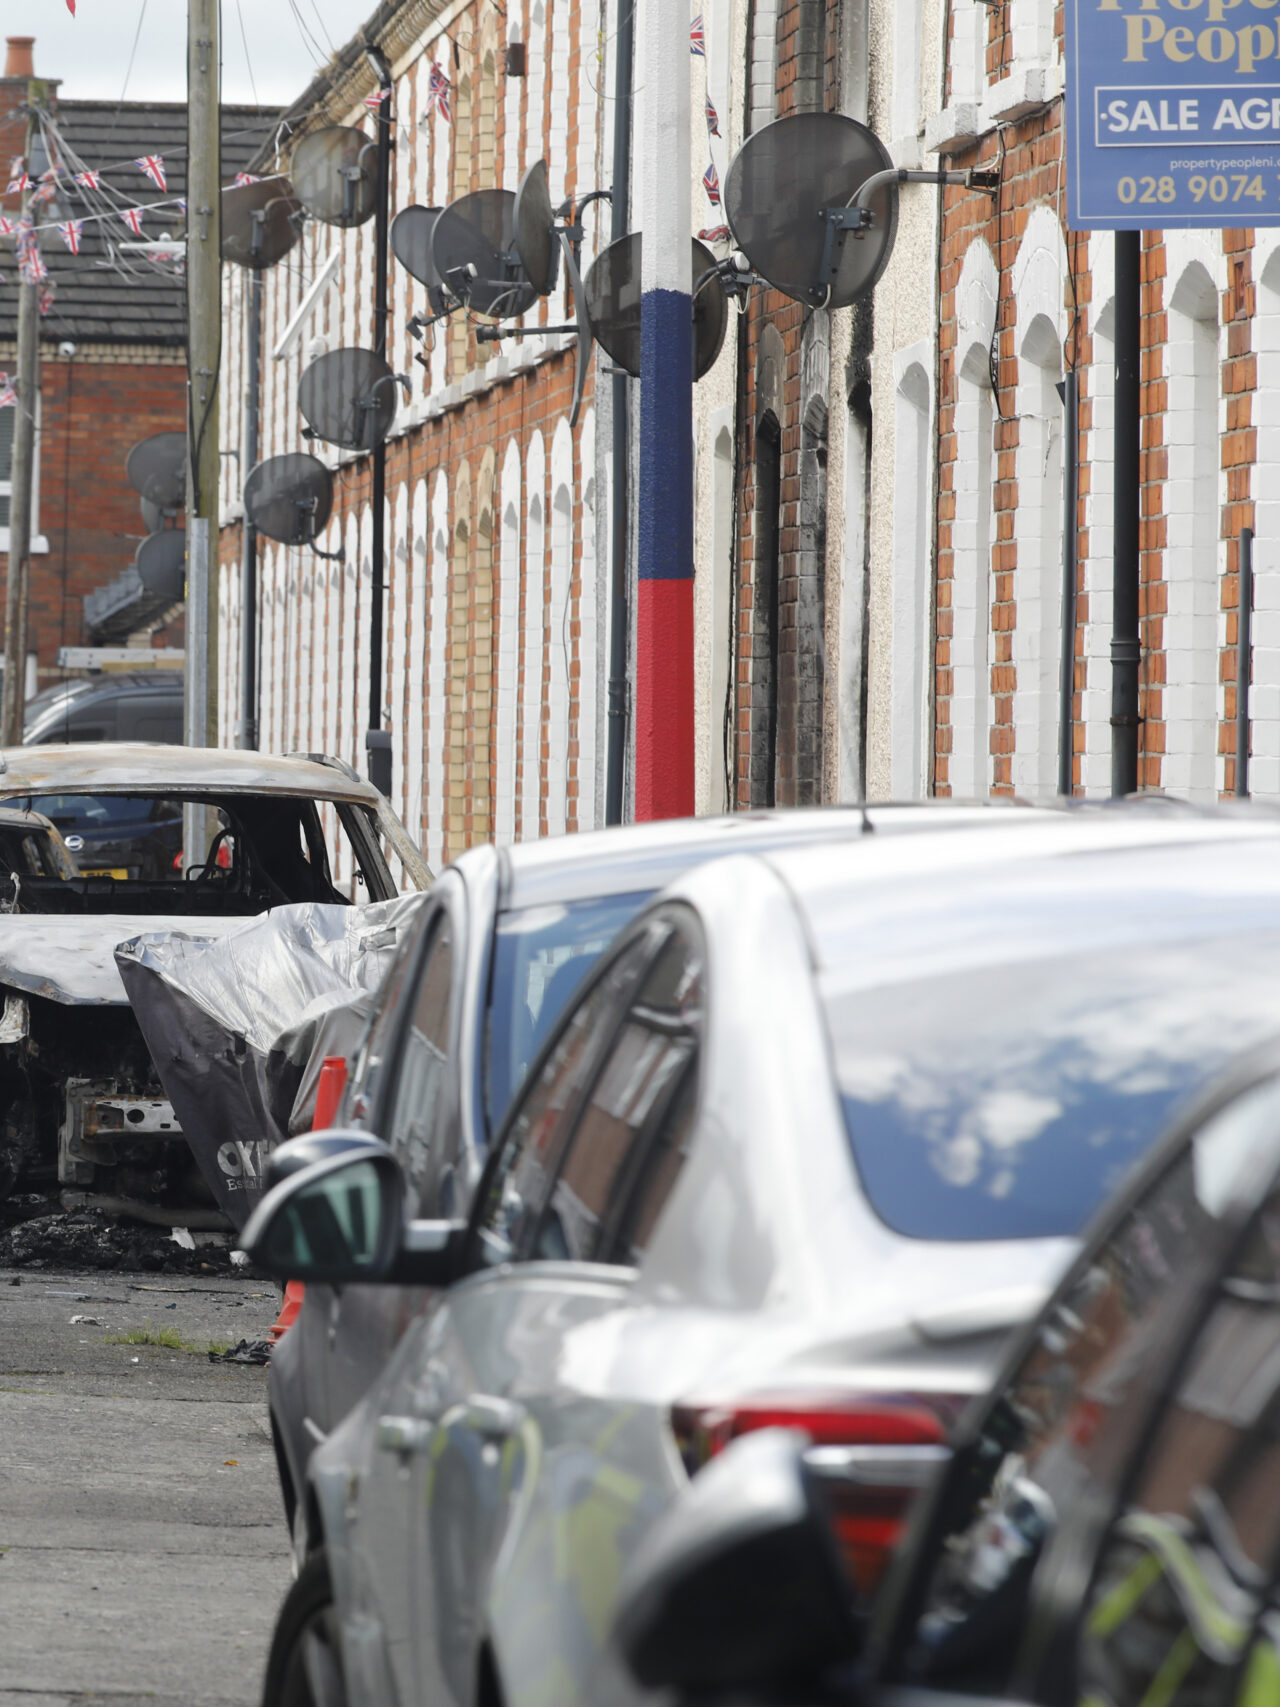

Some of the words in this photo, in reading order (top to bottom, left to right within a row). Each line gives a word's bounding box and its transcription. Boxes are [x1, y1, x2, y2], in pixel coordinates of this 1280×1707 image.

[1108, 100, 1199, 132] SALE
[1117, 176, 1176, 203] 028
[1188, 175, 1267, 202] 9074
